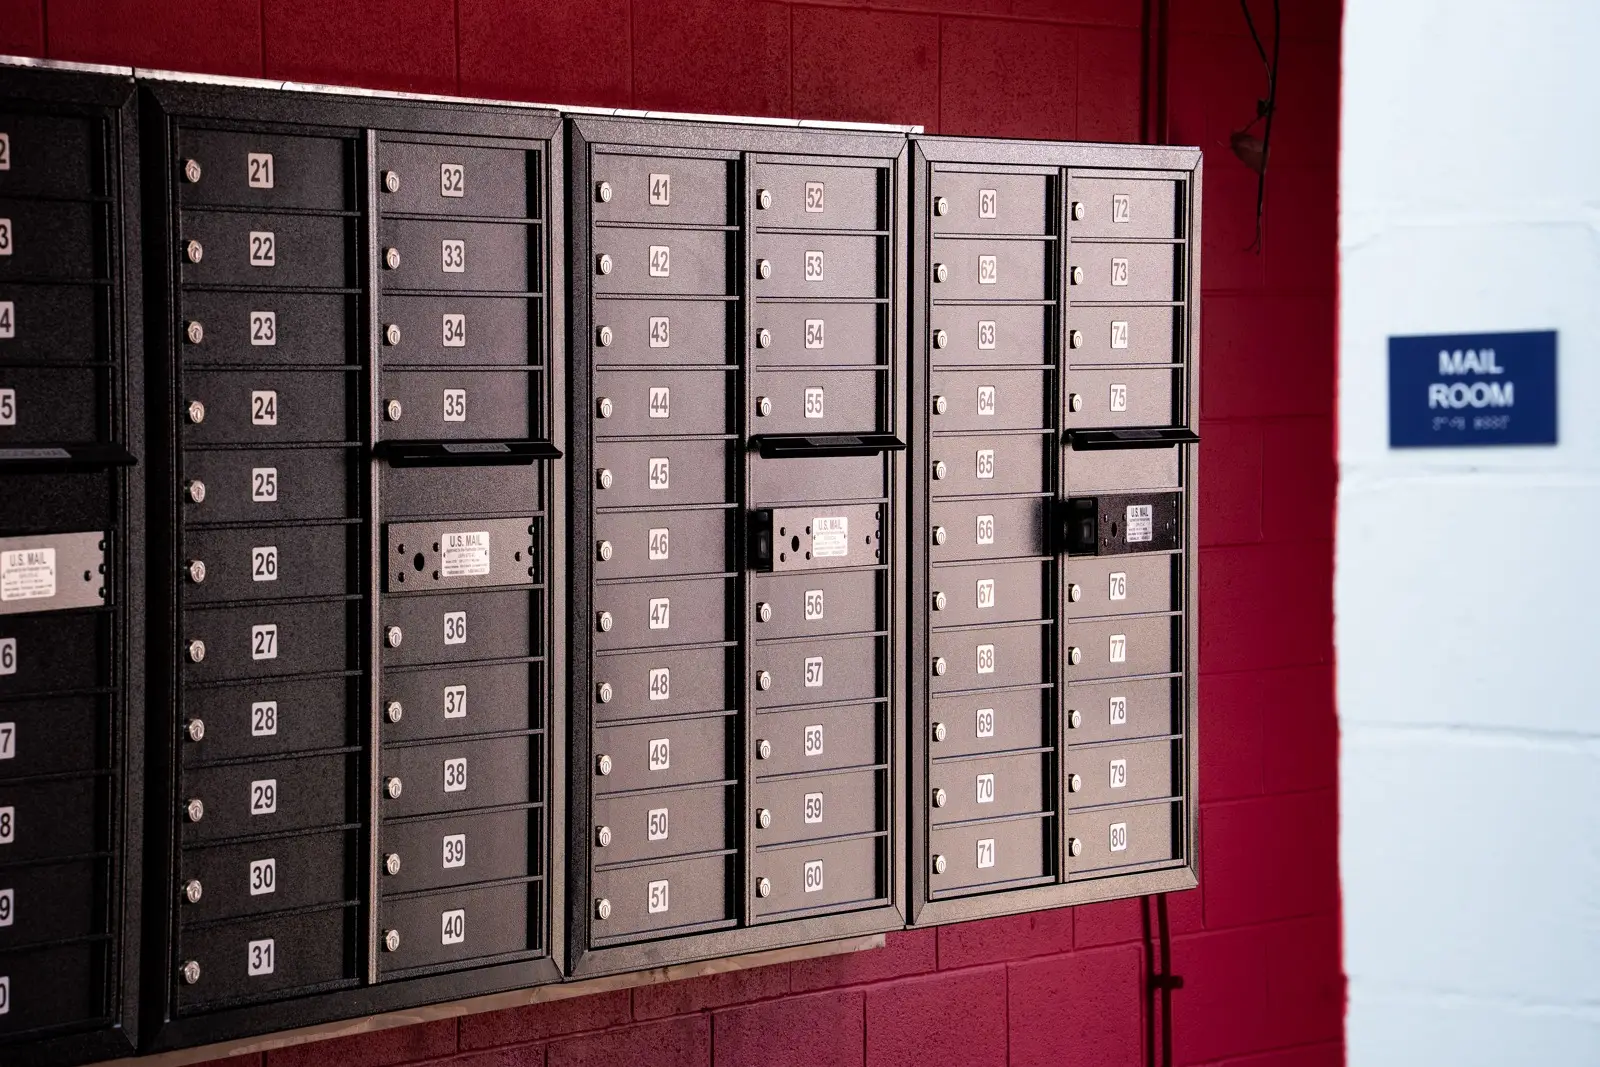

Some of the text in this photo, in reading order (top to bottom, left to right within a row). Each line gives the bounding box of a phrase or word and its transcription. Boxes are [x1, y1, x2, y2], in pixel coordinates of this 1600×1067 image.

[250, 158, 269, 183] 21
[443, 168, 462, 192] 32
[652, 179, 668, 201] 41
[807, 187, 822, 208] 52
[981, 193, 995, 214] 61
[1115, 198, 1128, 218] 72
[252, 236, 273, 260] 22
[444, 244, 463, 268] 33
[651, 250, 668, 272] 42
[807, 256, 822, 276] 53
[980, 260, 995, 280] 62
[1113, 262, 1127, 281] 73
[253, 317, 274, 340] 23
[444, 319, 464, 342] 34
[651, 321, 668, 343] 43
[807, 324, 823, 345] 54
[980, 324, 994, 345] 63
[1113, 325, 1126, 344] 74
[1438, 349, 1504, 375] MAIL
[446, 394, 464, 416] 35
[651, 392, 668, 413] 44
[806, 393, 822, 414] 55
[979, 391, 994, 411] 64
[1112, 388, 1126, 407] 75
[1428, 381, 1514, 409] ROOM
[254, 396, 275, 420] 24
[650, 463, 668, 484] 45
[978, 454, 992, 474] 65
[254, 473, 275, 496] 25
[818, 519, 842, 530] U.S. MAIL
[978, 520, 992, 540] 66
[450, 535, 482, 547] U.S. MAIL
[650, 534, 667, 554] 46
[10, 552, 46, 566] U.S. MAIL
[255, 552, 276, 576] 26
[978, 584, 992, 604] 67
[1111, 577, 1125, 596] 76
[651, 603, 668, 624] 47
[807, 594, 822, 616] 56
[446, 616, 464, 640] 36
[254, 630, 275, 654] 27
[1111, 639, 1124, 658] 77
[978, 649, 992, 669] 68
[806, 662, 822, 683] 57
[651, 674, 668, 695] 48
[446, 690, 465, 714] 37
[1111, 700, 1125, 720] 78
[254, 707, 274, 731] 28
[978, 713, 992, 733] 69
[806, 730, 822, 752] 58
[651, 744, 668, 765] 49
[446, 762, 465, 786] 38
[1111, 764, 1125, 784] 79
[254, 785, 274, 810] 29
[978, 778, 992, 798] 70
[806, 798, 822, 819] 59
[650, 813, 667, 836] 50
[1112, 827, 1125, 848] 80
[445, 840, 464, 863] 39
[979, 843, 992, 864] 71
[253, 864, 273, 890] 30
[806, 865, 822, 888] 60
[651, 885, 666, 908] 51
[444, 915, 463, 938] 40
[252, 944, 271, 970] 31
